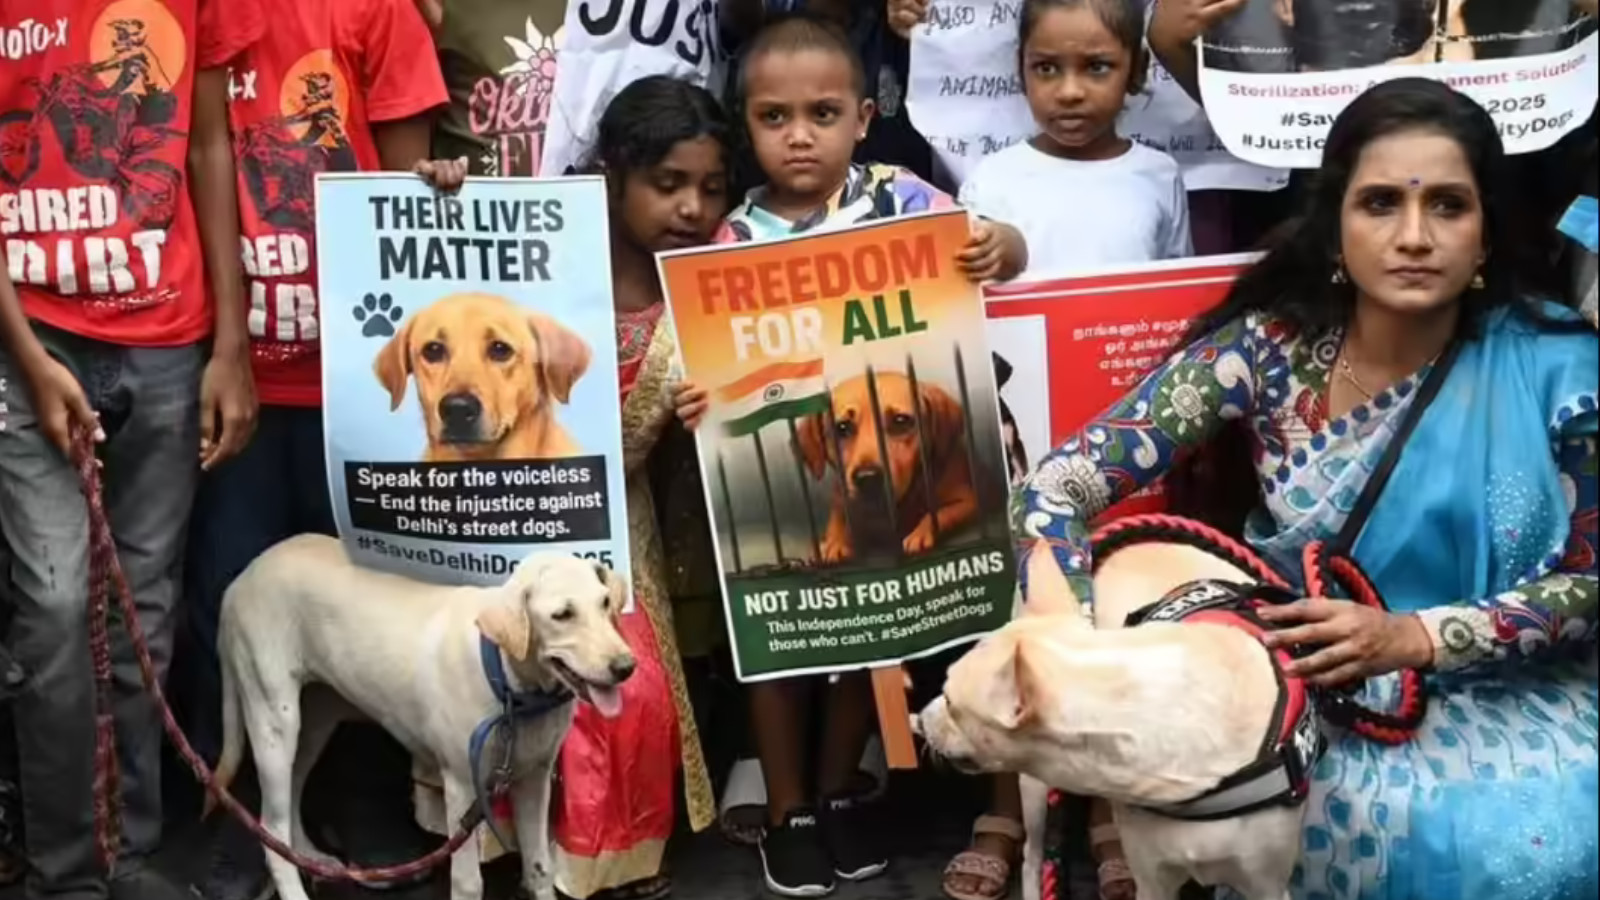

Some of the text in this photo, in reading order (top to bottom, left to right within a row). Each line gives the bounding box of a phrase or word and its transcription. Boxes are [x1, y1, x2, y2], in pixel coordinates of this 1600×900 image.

[0, 17, 68, 60] OTO-X
[1228, 80, 1360, 98] Sterilization:
[1516, 54, 1587, 82] Solution
[1242, 134, 1327, 151] #Justic
[1499, 110, 1574, 139] ityDogs
[368, 195, 564, 233] THEIR LIVES
[379, 236, 551, 282] MATTER
[697, 234, 939, 315] FREEDOM
[730, 289, 928, 363] FOR ALL
[357, 465, 591, 490] Speak for the voiceless
[380, 493, 415, 512] End
[420, 495, 451, 512] the
[455, 493, 534, 516] injustice
[538, 491, 603, 514] against
[396, 515, 570, 539] Delhi's street dogs.
[744, 551, 1004, 616] NOT JUST FOR HUMANS
[766, 584, 986, 634] This Independence Day, speak for
[768, 602, 993, 652] those who can't. #SaveStreetDogs
